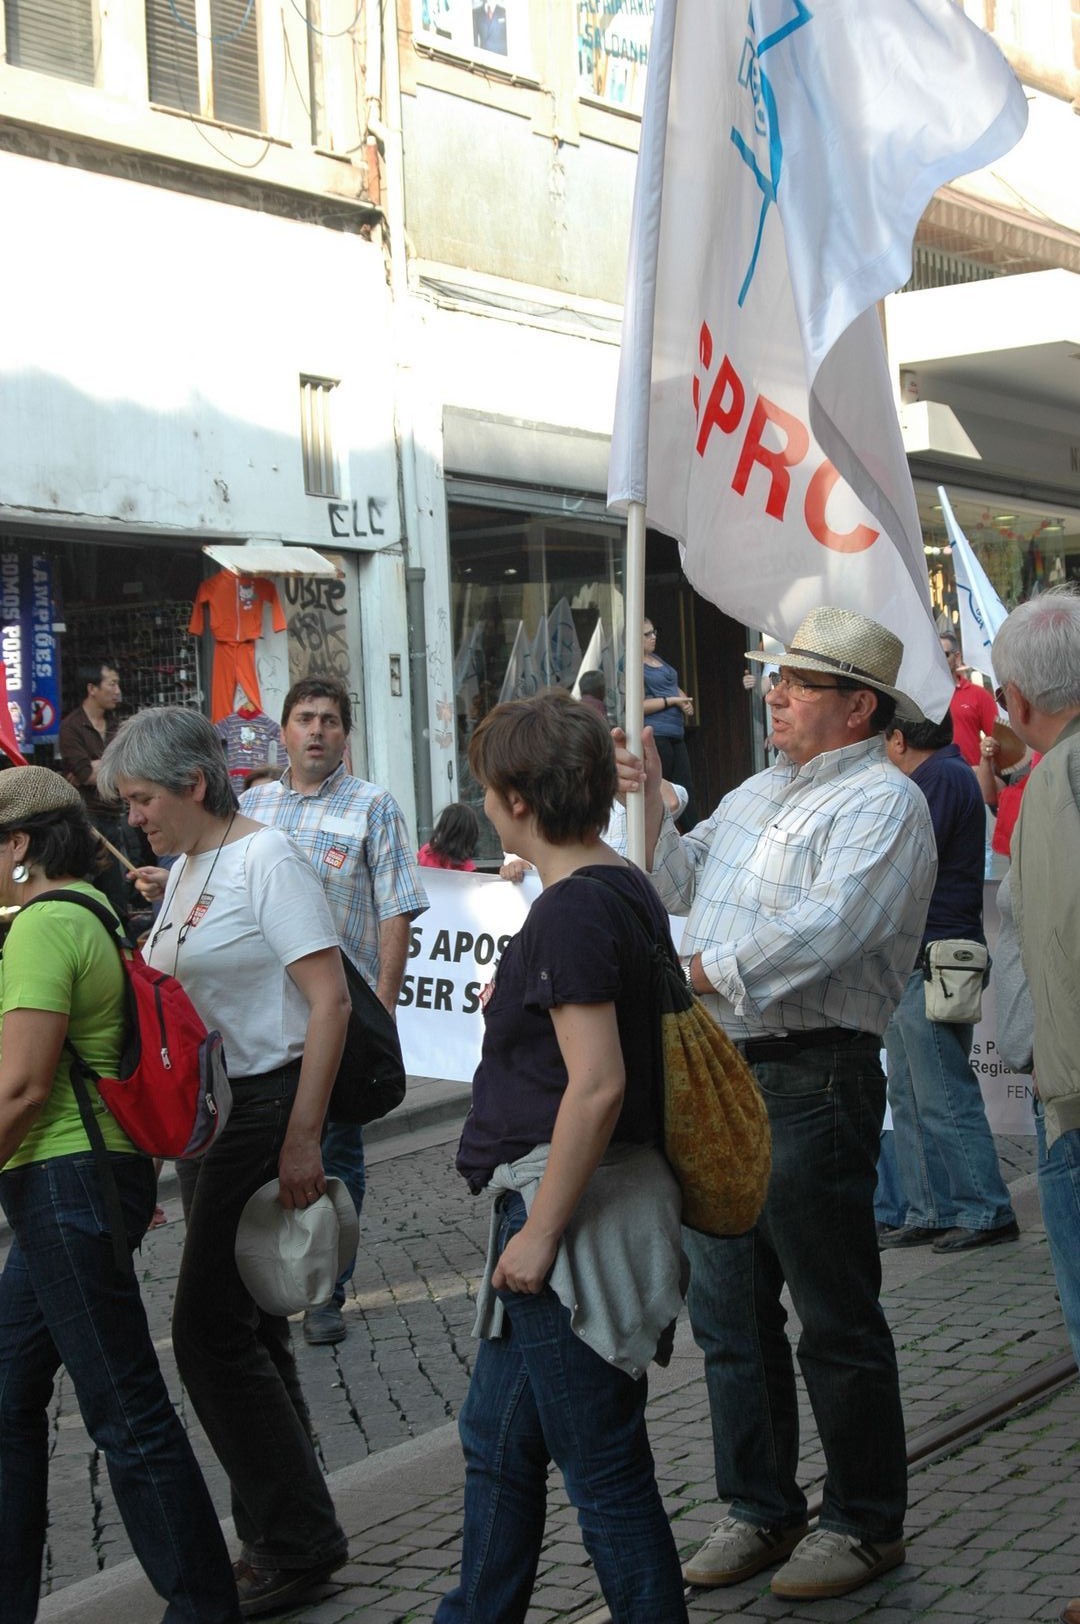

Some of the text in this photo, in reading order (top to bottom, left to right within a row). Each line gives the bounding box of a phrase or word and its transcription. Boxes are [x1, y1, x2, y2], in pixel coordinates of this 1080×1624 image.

[1, 553, 20, 620] SOMOS
[3, 624, 22, 692] PORTO
[398, 975, 455, 1012] SER
